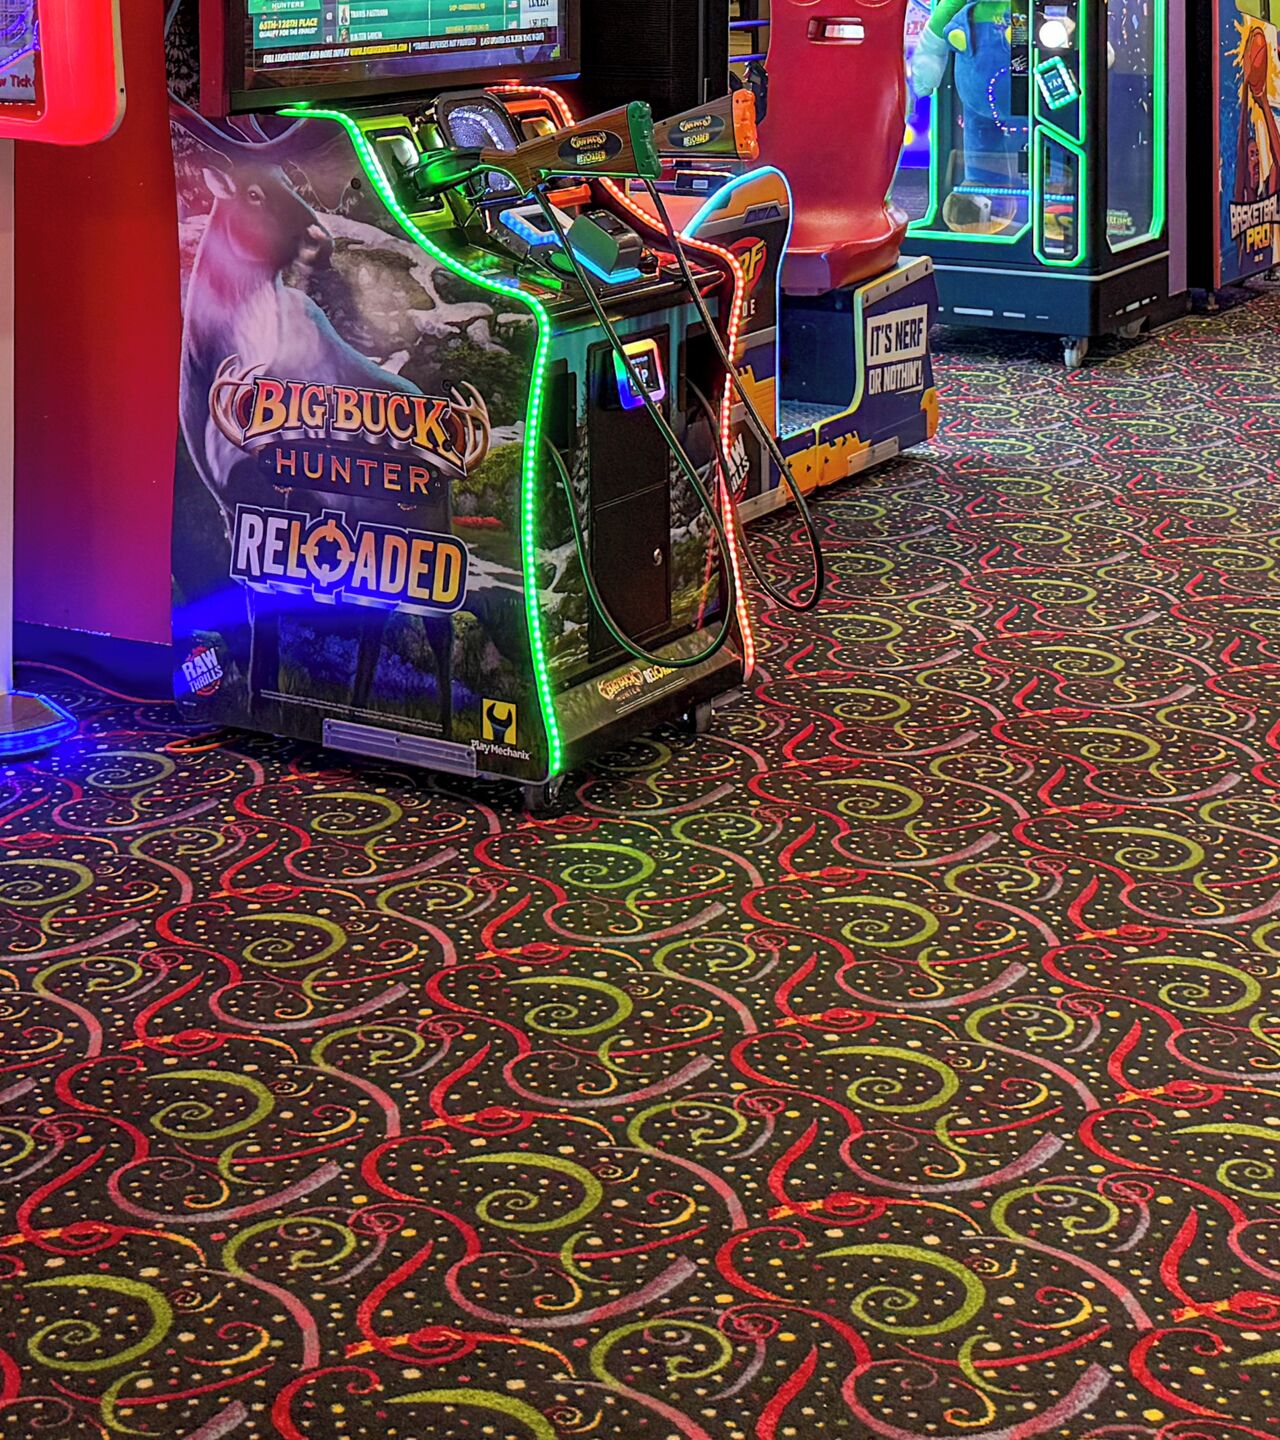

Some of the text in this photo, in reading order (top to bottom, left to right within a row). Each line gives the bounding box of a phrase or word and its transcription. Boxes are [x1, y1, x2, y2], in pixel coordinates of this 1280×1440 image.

[272, 1, 305, 9] HUNTERS
[1246, 224, 1270, 253] PRO
[870, 317, 923, 357] IT'S NERF
[869, 369, 883, 395] OR
[246, 381, 452, 453] BIG BUCK
[274, 448, 432, 495] HUNTER
[238, 510, 462, 604] RELOADED
[182, 648, 220, 682] RAW
[188, 665, 224, 694] THRILLS
